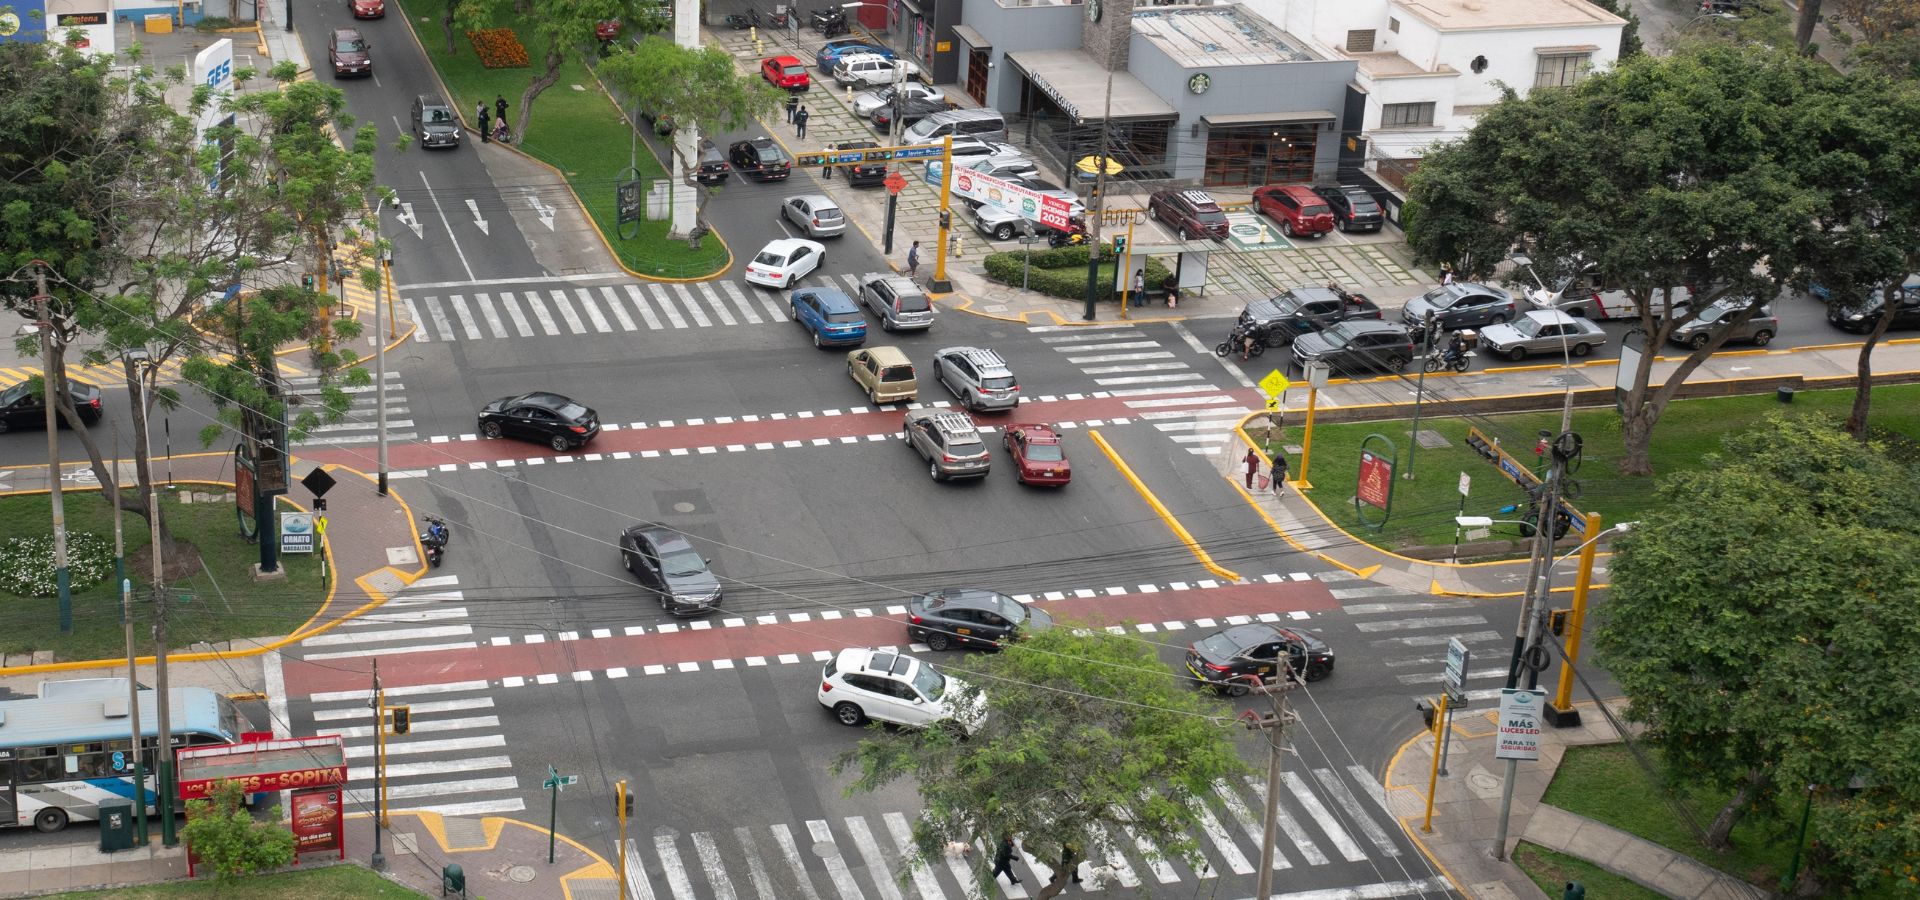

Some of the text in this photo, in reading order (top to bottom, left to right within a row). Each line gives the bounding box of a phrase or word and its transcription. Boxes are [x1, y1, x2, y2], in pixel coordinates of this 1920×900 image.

[1029, 71, 1078, 118] STARBUCKS COFFEE
[976, 173, 1006, 187] BENEFICIOS
[1042, 204, 1069, 218] DICIEMBRE
[1042, 211, 1067, 227] 2023
[283, 535, 310, 543] ORNATO
[1508, 718, 1533, 728] MÁS
[187, 784, 203, 792] LOS
[264, 777, 276, 785] DE
[279, 767, 343, 787] SOPITA
